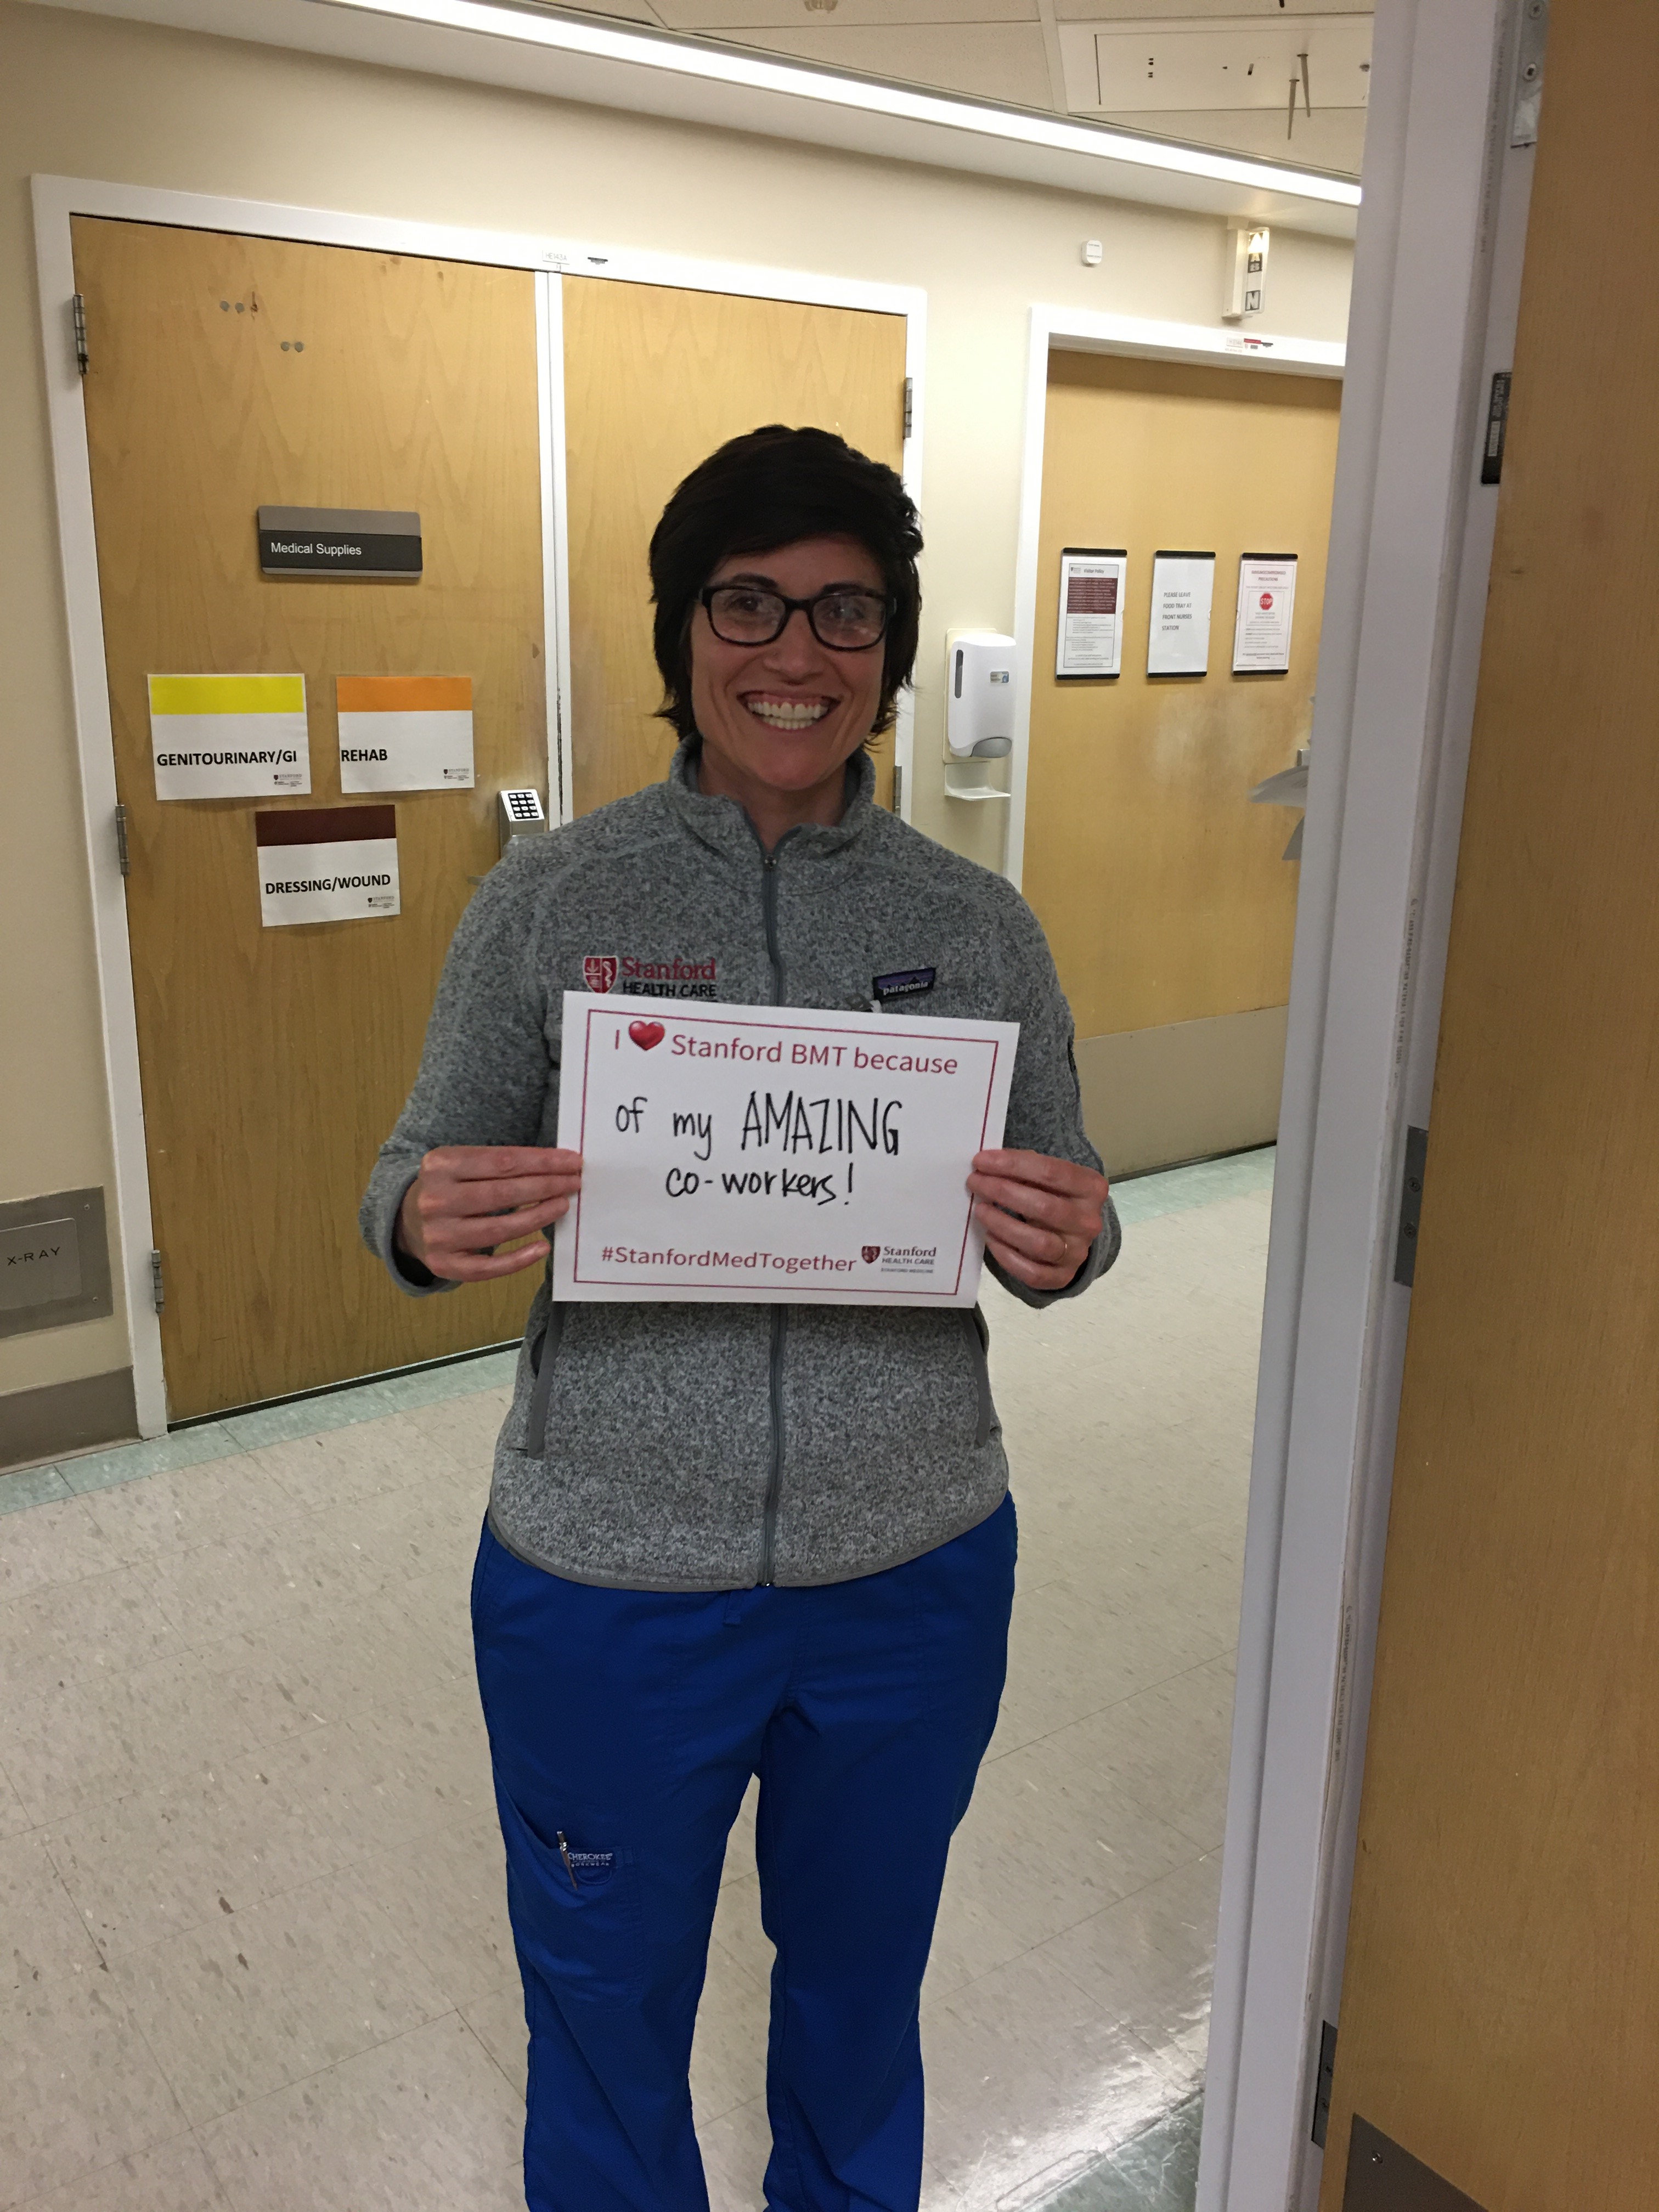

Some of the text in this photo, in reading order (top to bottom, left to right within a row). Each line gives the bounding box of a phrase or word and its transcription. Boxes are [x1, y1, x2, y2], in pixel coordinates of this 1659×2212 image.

[271, 542, 362, 557] Medical Supplies
[156, 750, 297, 766] GENITOURINARY/GI
[341, 748, 388, 762] REHAB
[265, 873, 391, 895] DRESSING/WOUND
[622, 956, 716, 980] Stanford
[623, 980, 718, 997] HEALTH CARE
[883, 980, 928, 996] patagonia
[614, 1029, 958, 1074] I Stanford BMT because
[614, 1090, 902, 1161] of my AMAZING
[666, 1162, 855, 1206] co-workers!
[7, 1246, 60, 1266] X-RAY
[601, 1246, 857, 1274] #StanfordMedTogether
[883, 1246, 936, 1257] Stanford
[567, 1852, 613, 1861] CHEROKEE
